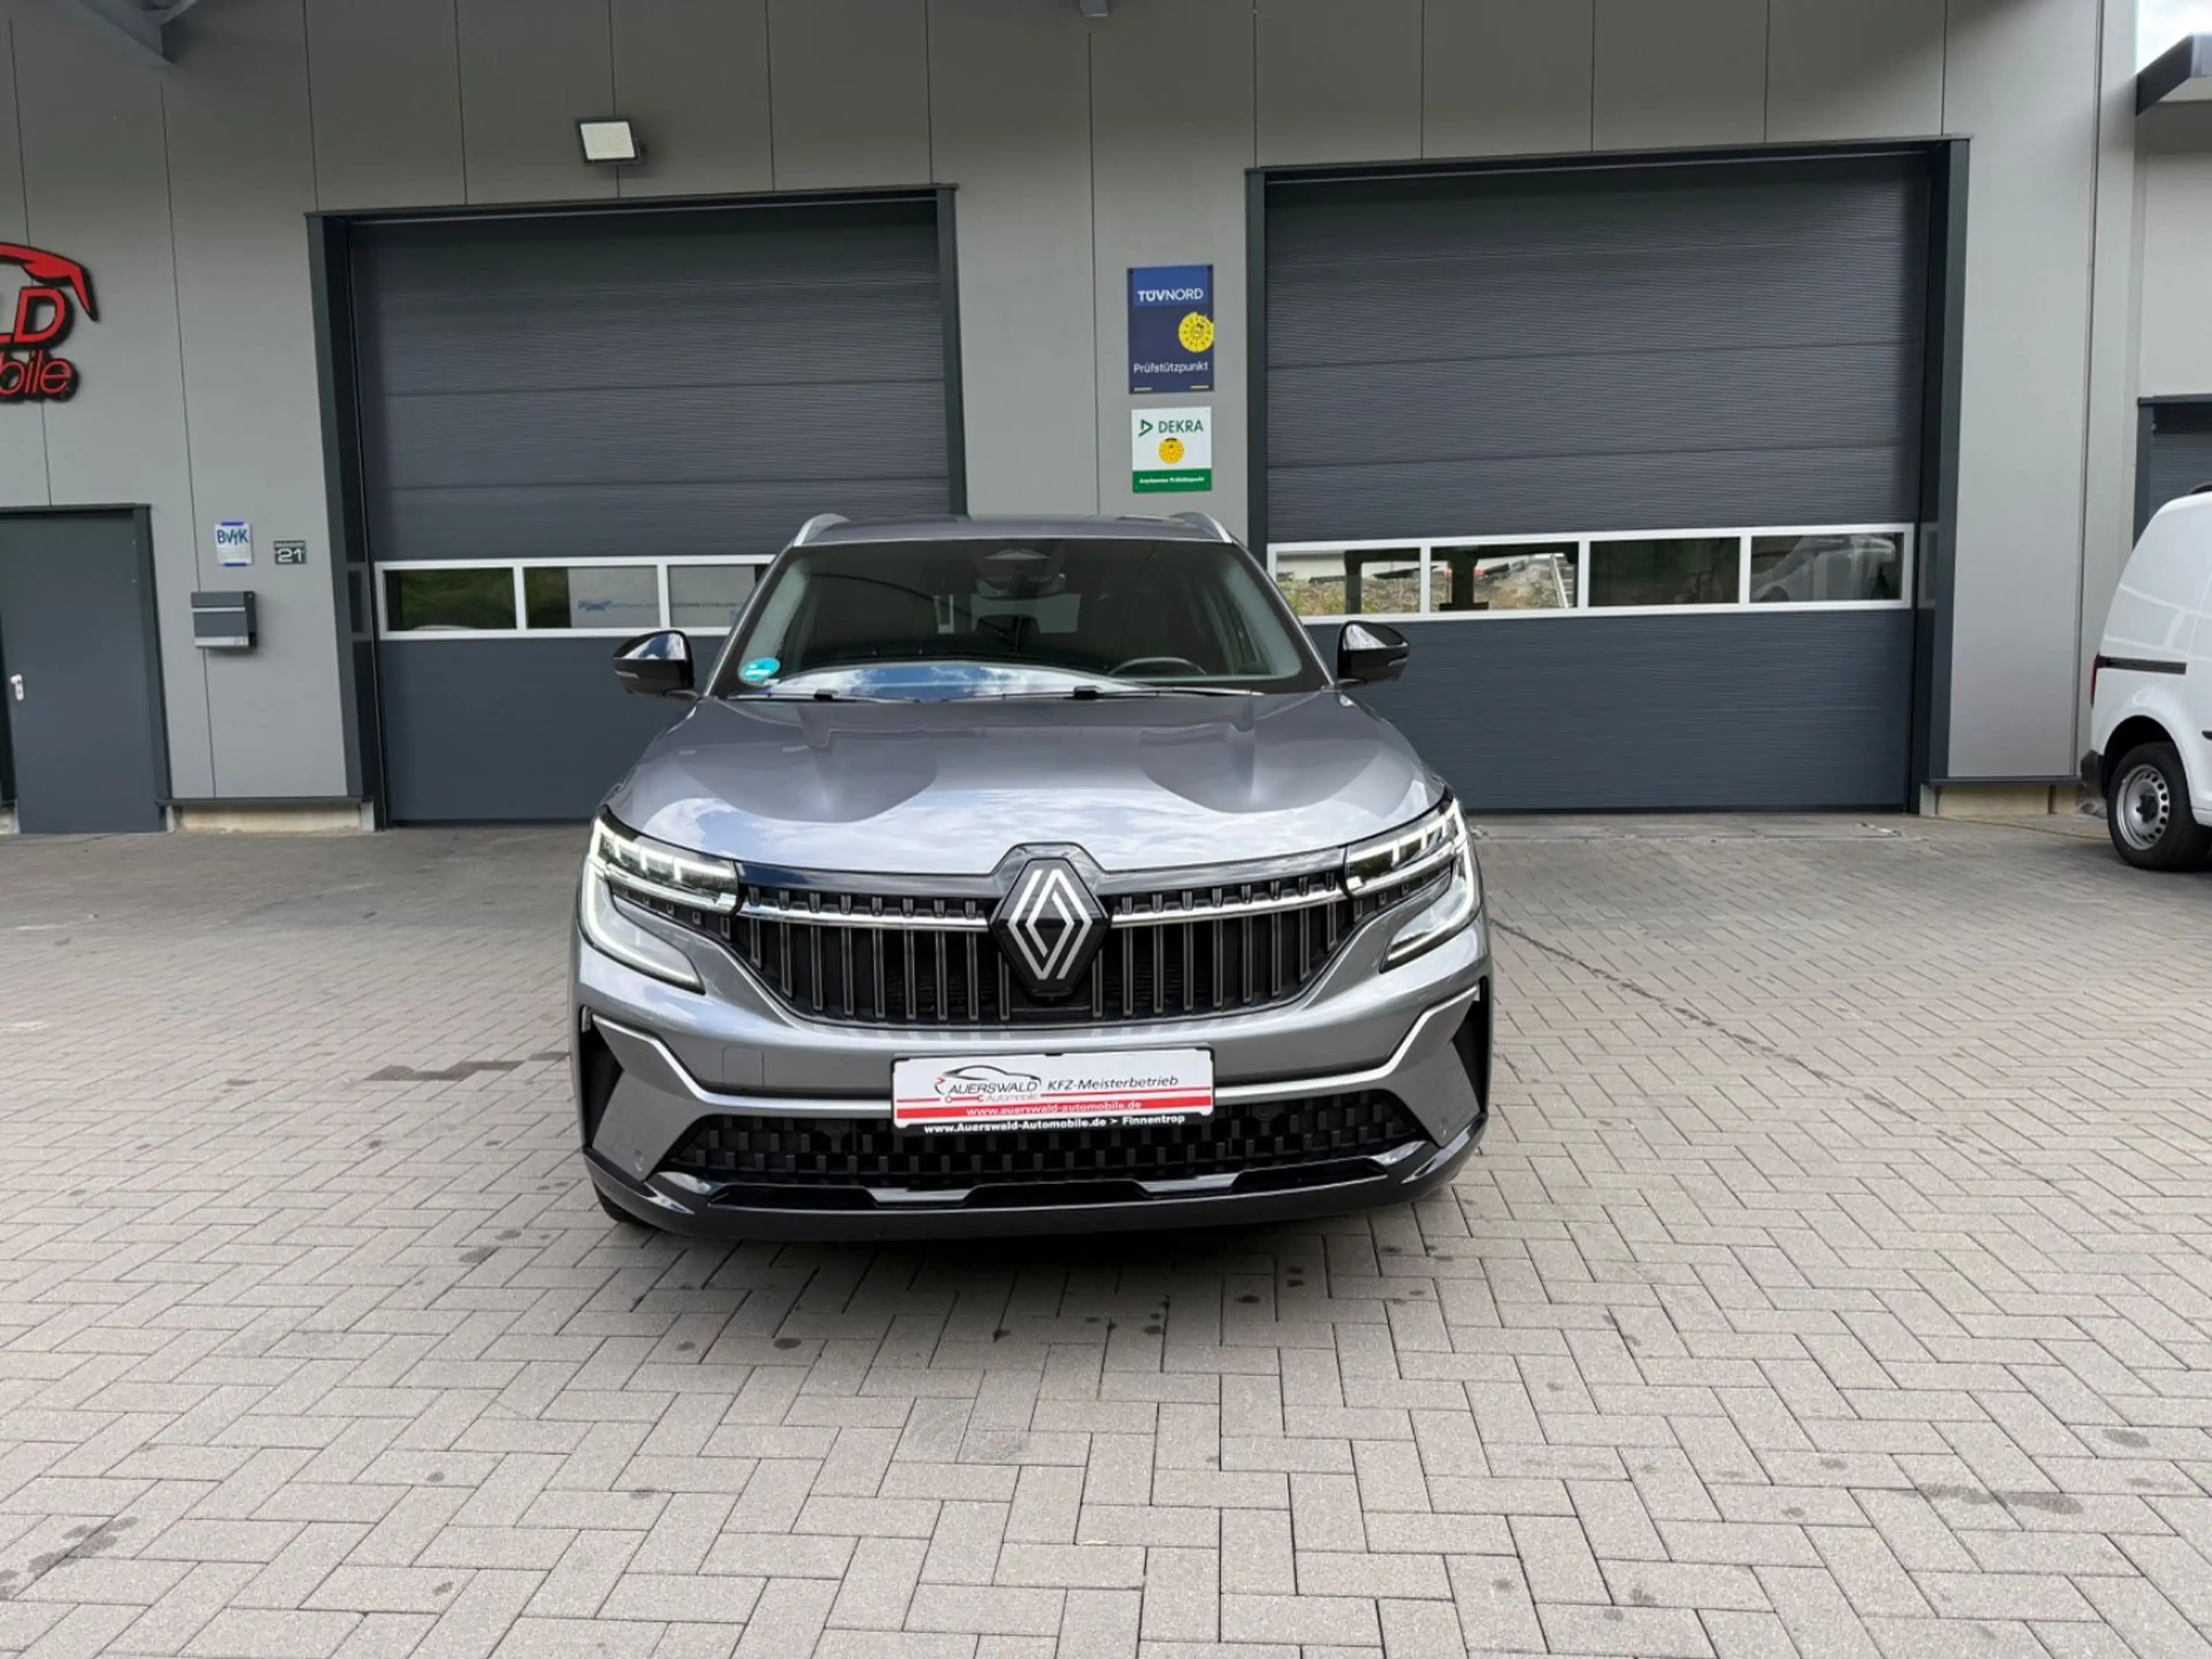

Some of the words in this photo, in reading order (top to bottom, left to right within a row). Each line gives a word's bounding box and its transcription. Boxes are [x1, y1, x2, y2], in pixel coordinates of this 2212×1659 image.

[1133, 361, 1208, 374] Prüfstützpunkt
[1158, 419, 1205, 434] DEKRA
[278, 548, 302, 563] 21
[950, 1081, 1037, 1094] AUERSWALD
[1048, 1075, 1178, 1090] KFZ-Meisterbetrieb
[966, 1100, 1142, 1116] www.auerswald-automobile.de
[924, 1118, 1106, 1133] www.Auerswald-Automobile.de
[1123, 1113, 1185, 1127] Finnentrop
